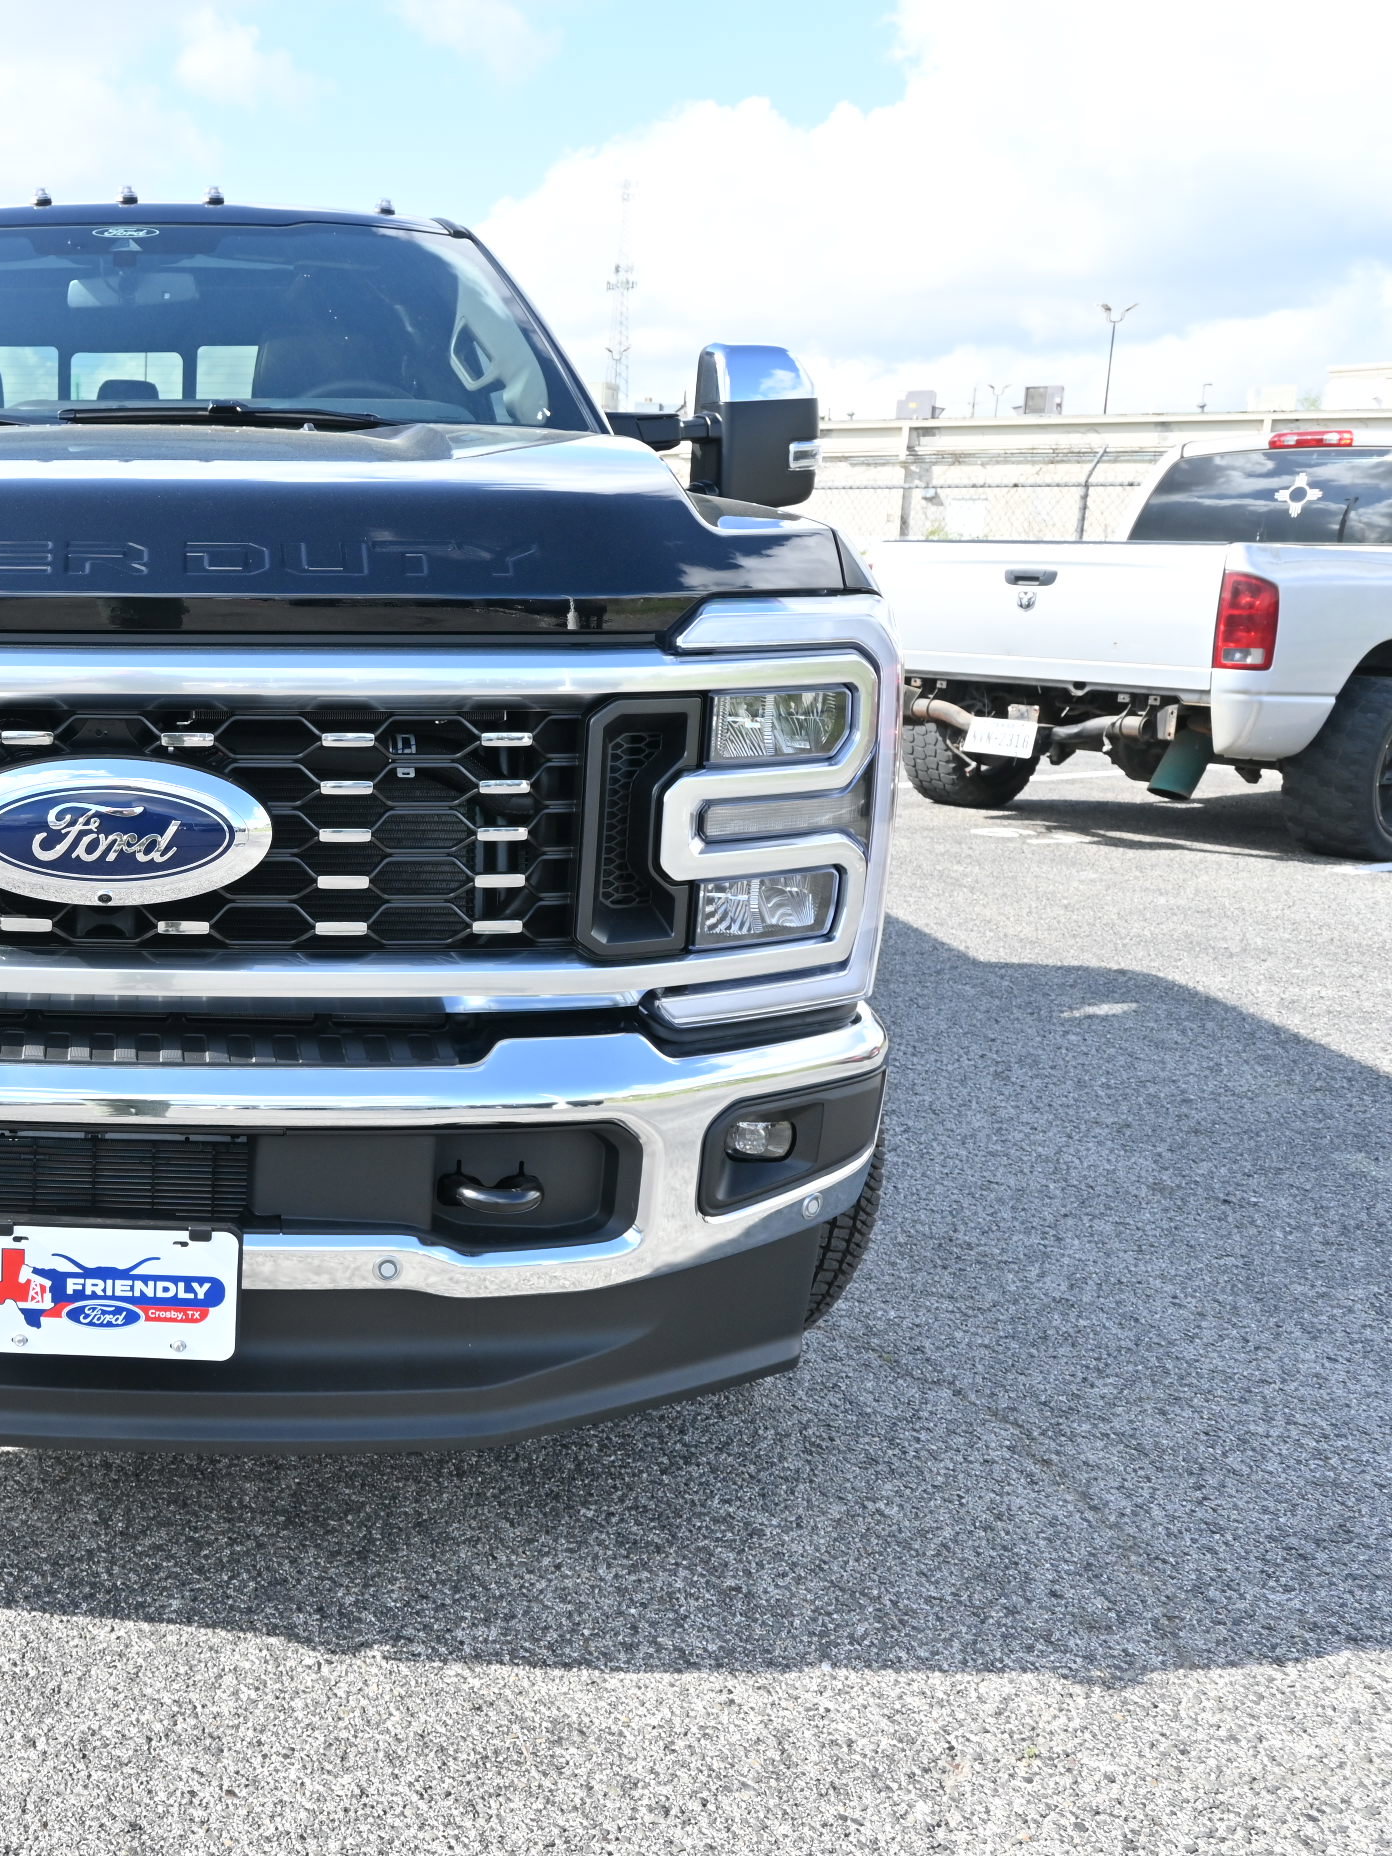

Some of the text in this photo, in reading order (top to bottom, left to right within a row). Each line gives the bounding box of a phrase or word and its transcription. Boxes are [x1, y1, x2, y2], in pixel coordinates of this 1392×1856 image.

[104, 228, 147, 236] Ford
[182, 540, 540, 577] DUTY
[31, 802, 182, 864] Ford
[66, 1277, 212, 1300] FRIENDLY
[79, 1305, 127, 1325] Ford
[148, 1309, 201, 1321] Crosby, TX
